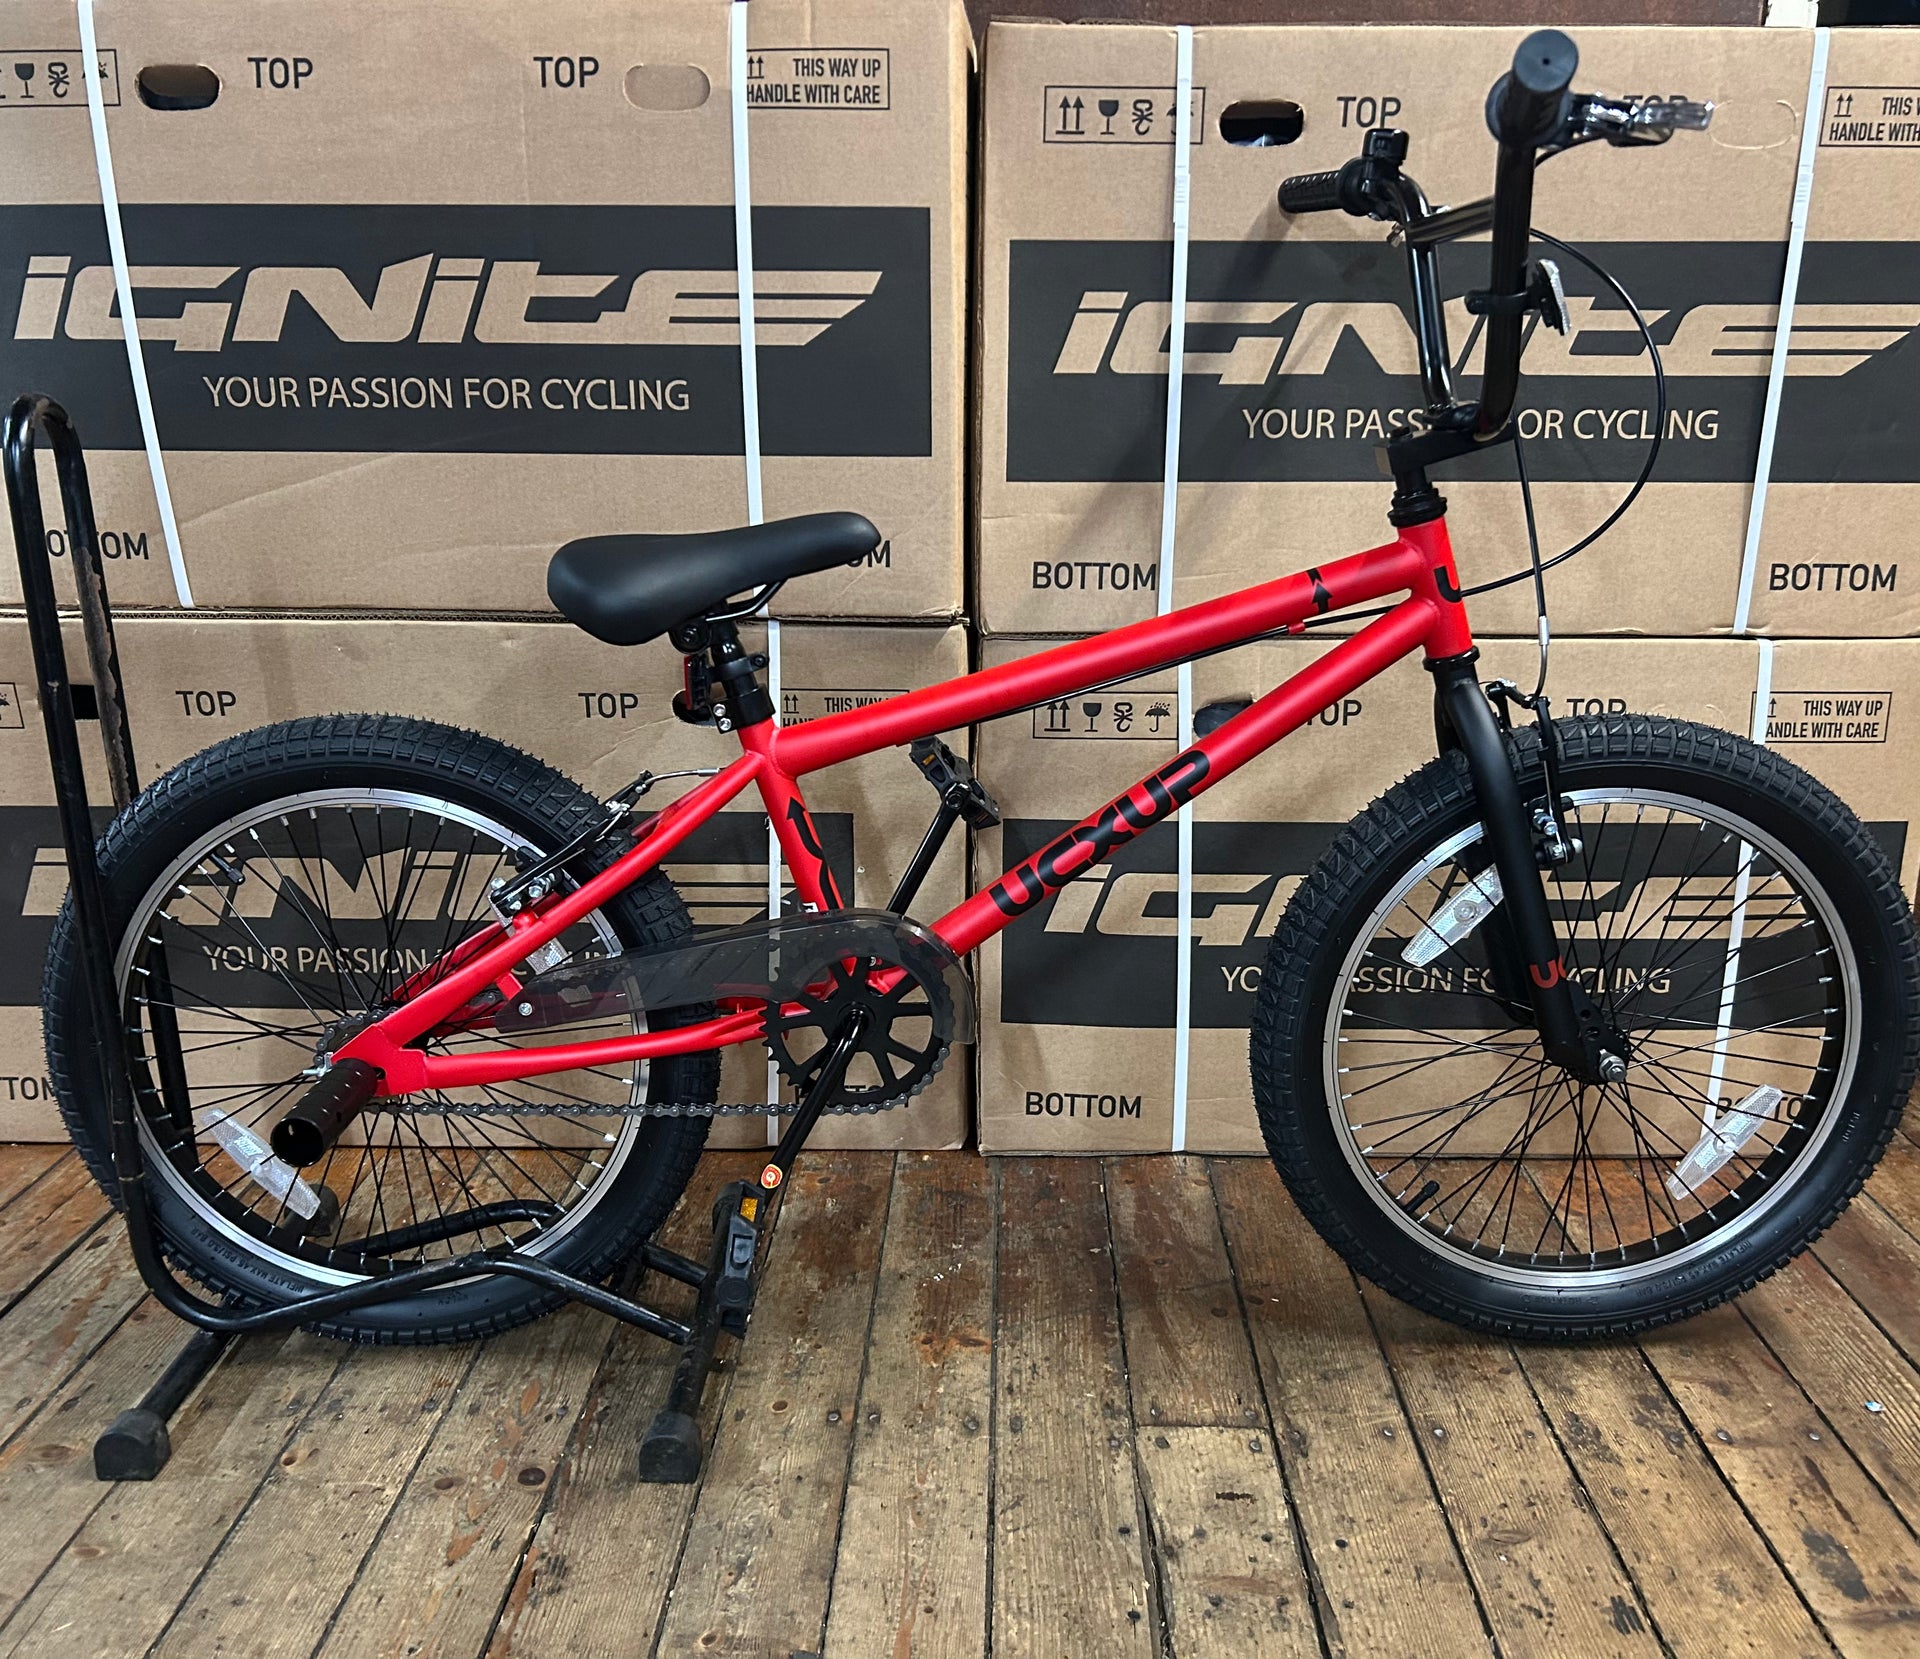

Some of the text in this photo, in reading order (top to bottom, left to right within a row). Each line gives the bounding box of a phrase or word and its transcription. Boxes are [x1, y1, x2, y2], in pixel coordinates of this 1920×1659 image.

[247, 57, 313, 89] TOP
[533, 56, 600, 88] TOP
[793, 58, 881, 77] THIS WAY UP
[747, 84, 880, 104] HANDLE WITH CARE
[1882, 97, 1913, 115] THIS
[1336, 96, 1402, 128] TOP
[1829, 122, 1885, 141] HANDLE
[203, 376, 690, 411] YOUR PASSION FOR CYCLING
[1242, 408, 1335, 439] YOUR
[1345, 408, 1432, 439] PASS
[1517, 408, 1563, 439] OR
[1033, 561, 1157, 591] BOTTOM
[1768, 563, 1898, 592] BOTTOM
[176, 690, 237, 717] TOP
[578, 692, 639, 719] TOP
[824, 697, 852, 713] THIS
[1307, 699, 1362, 726] OP
[1803, 700, 1883, 716] THIS WAY UP
[1766, 722, 1879, 738] ANDLE WITH CARE
[202, 945, 289, 972] YOUR
[298, 947, 428, 974] PASSION
[1220, 966, 1262, 992] YO
[1351, 966, 1453, 993] SSION
[1025, 1092, 1142, 1119] BOTTOM
